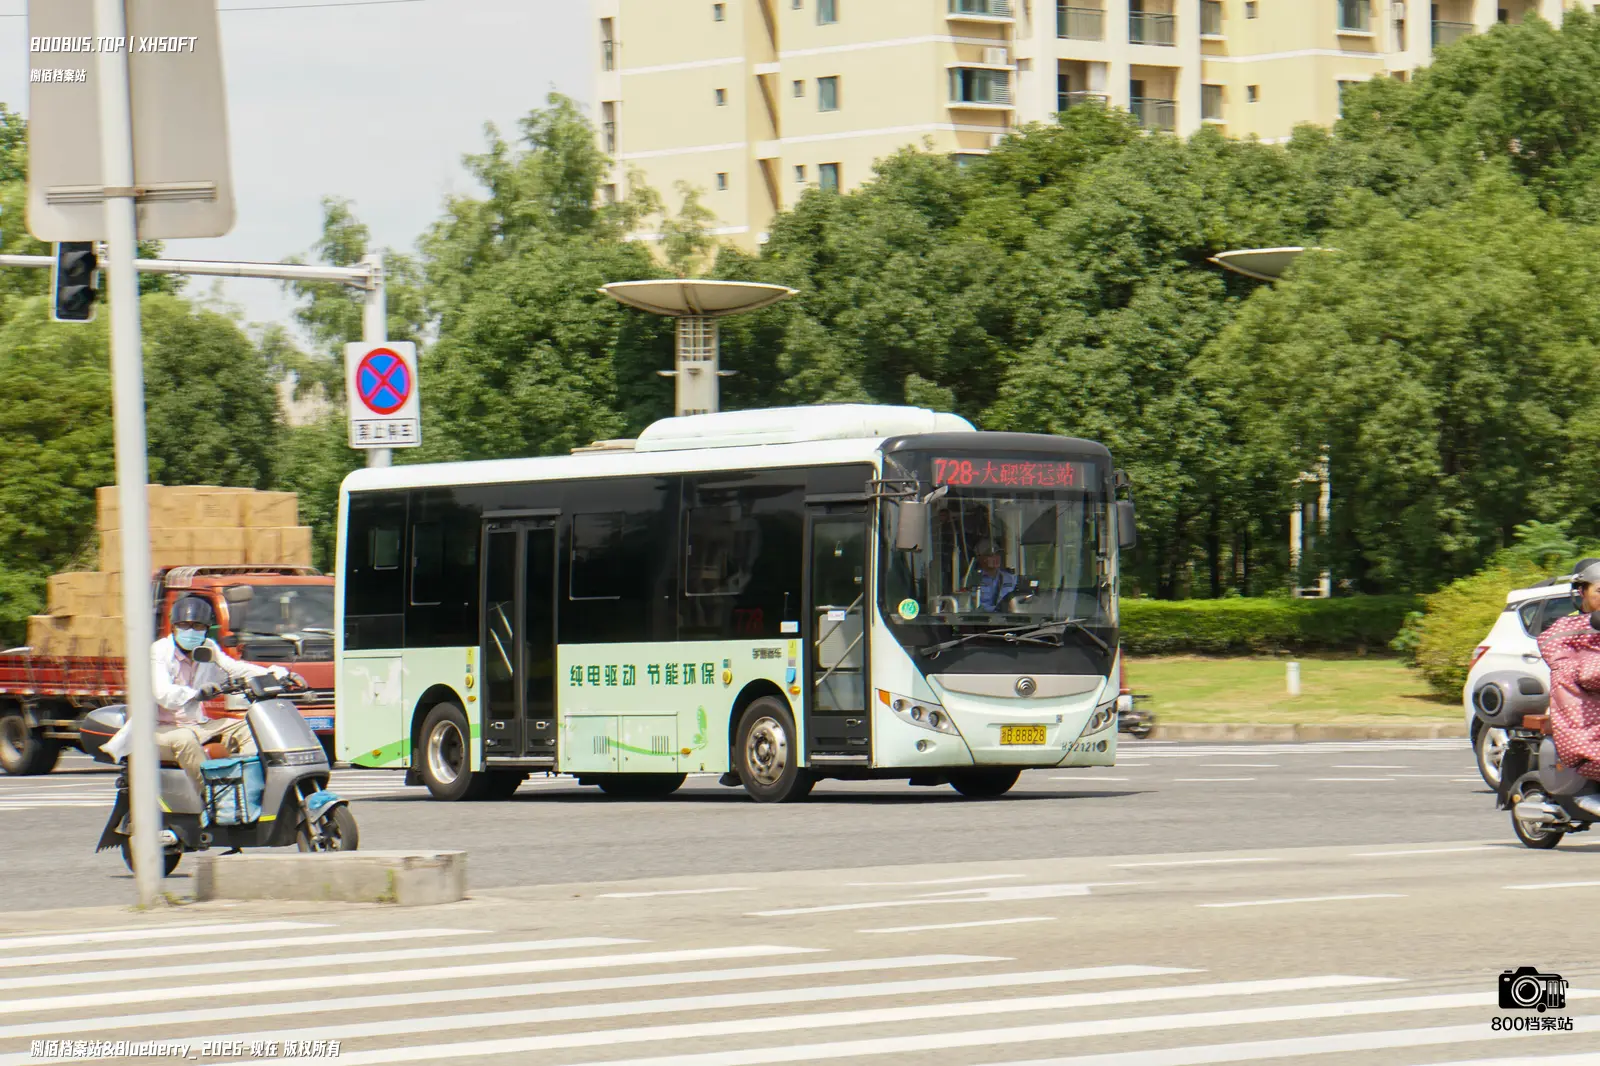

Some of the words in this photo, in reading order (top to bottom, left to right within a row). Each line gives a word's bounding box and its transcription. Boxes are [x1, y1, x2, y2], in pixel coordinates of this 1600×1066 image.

[569, 664, 637, 687] 纯电驱动
[646, 662, 716, 686] 节能环保
